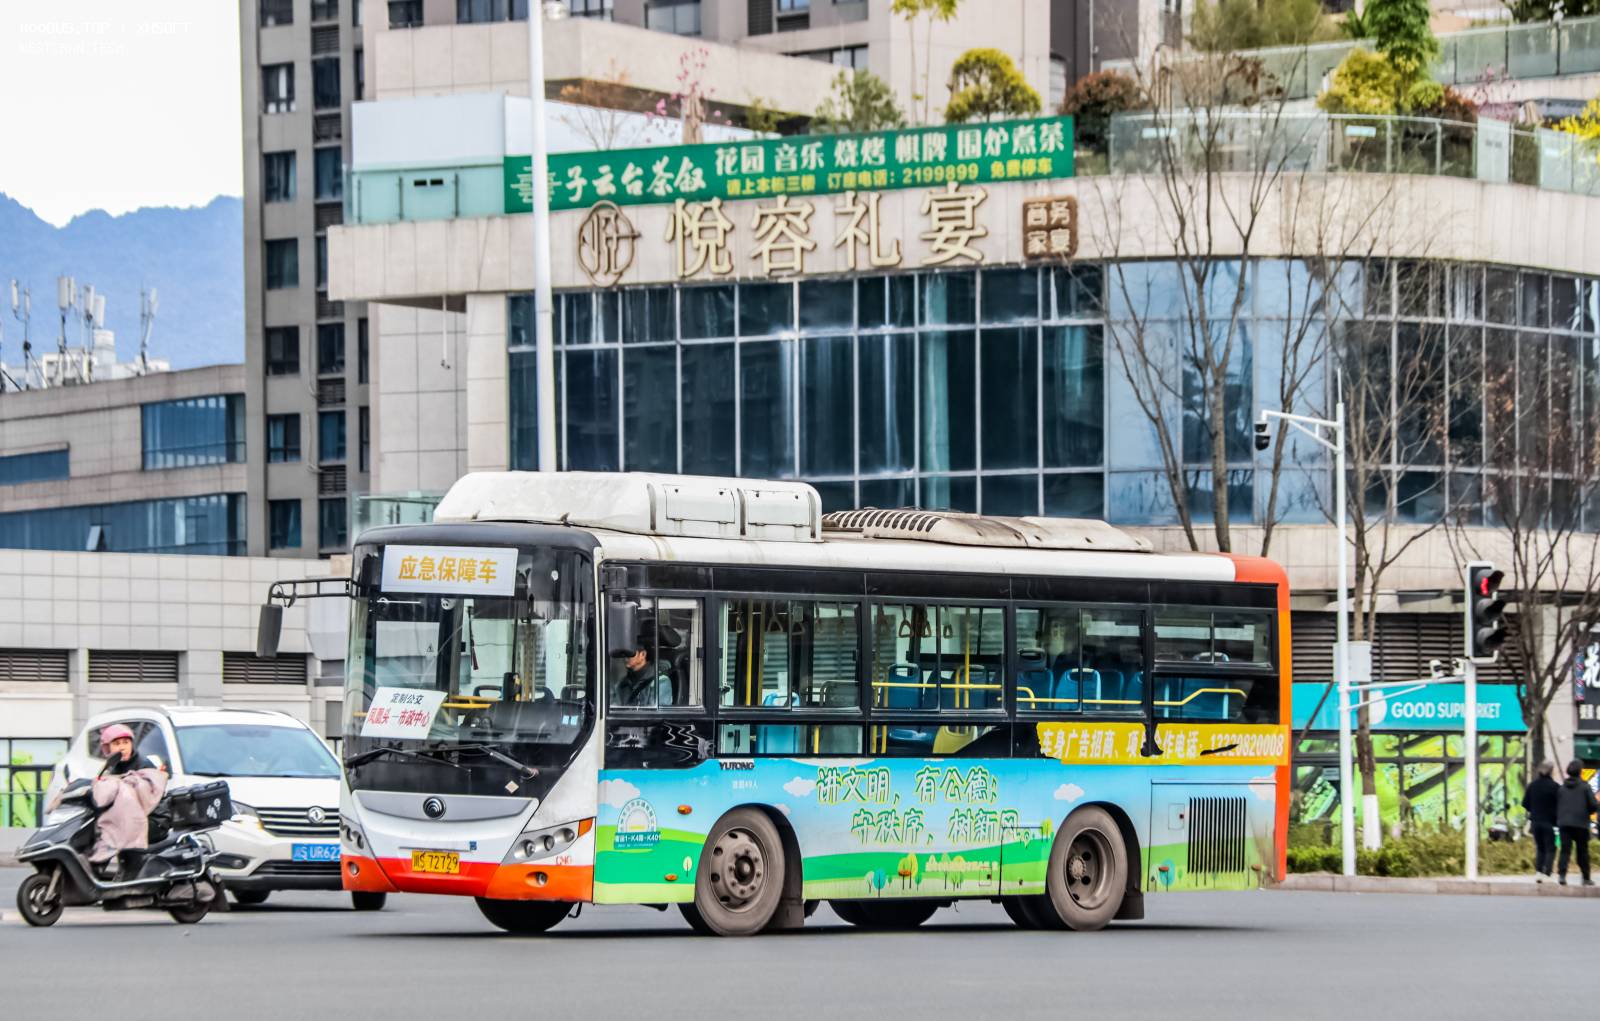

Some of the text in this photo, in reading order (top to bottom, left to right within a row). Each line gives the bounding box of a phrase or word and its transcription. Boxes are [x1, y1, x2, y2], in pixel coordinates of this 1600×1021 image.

[565, 121, 1064, 202] 子云台茶叙 花园 音乐 烧烤 棋牌 围炉煮茶
[991, 157, 1052, 179] 免费停车
[398, 555, 498, 584] 应急保障车
[390, 693, 425, 705] 定制公交
[1391, 701, 1501, 718] GOOD SUPRKET
[719, 761, 755, 770] YUTONG
